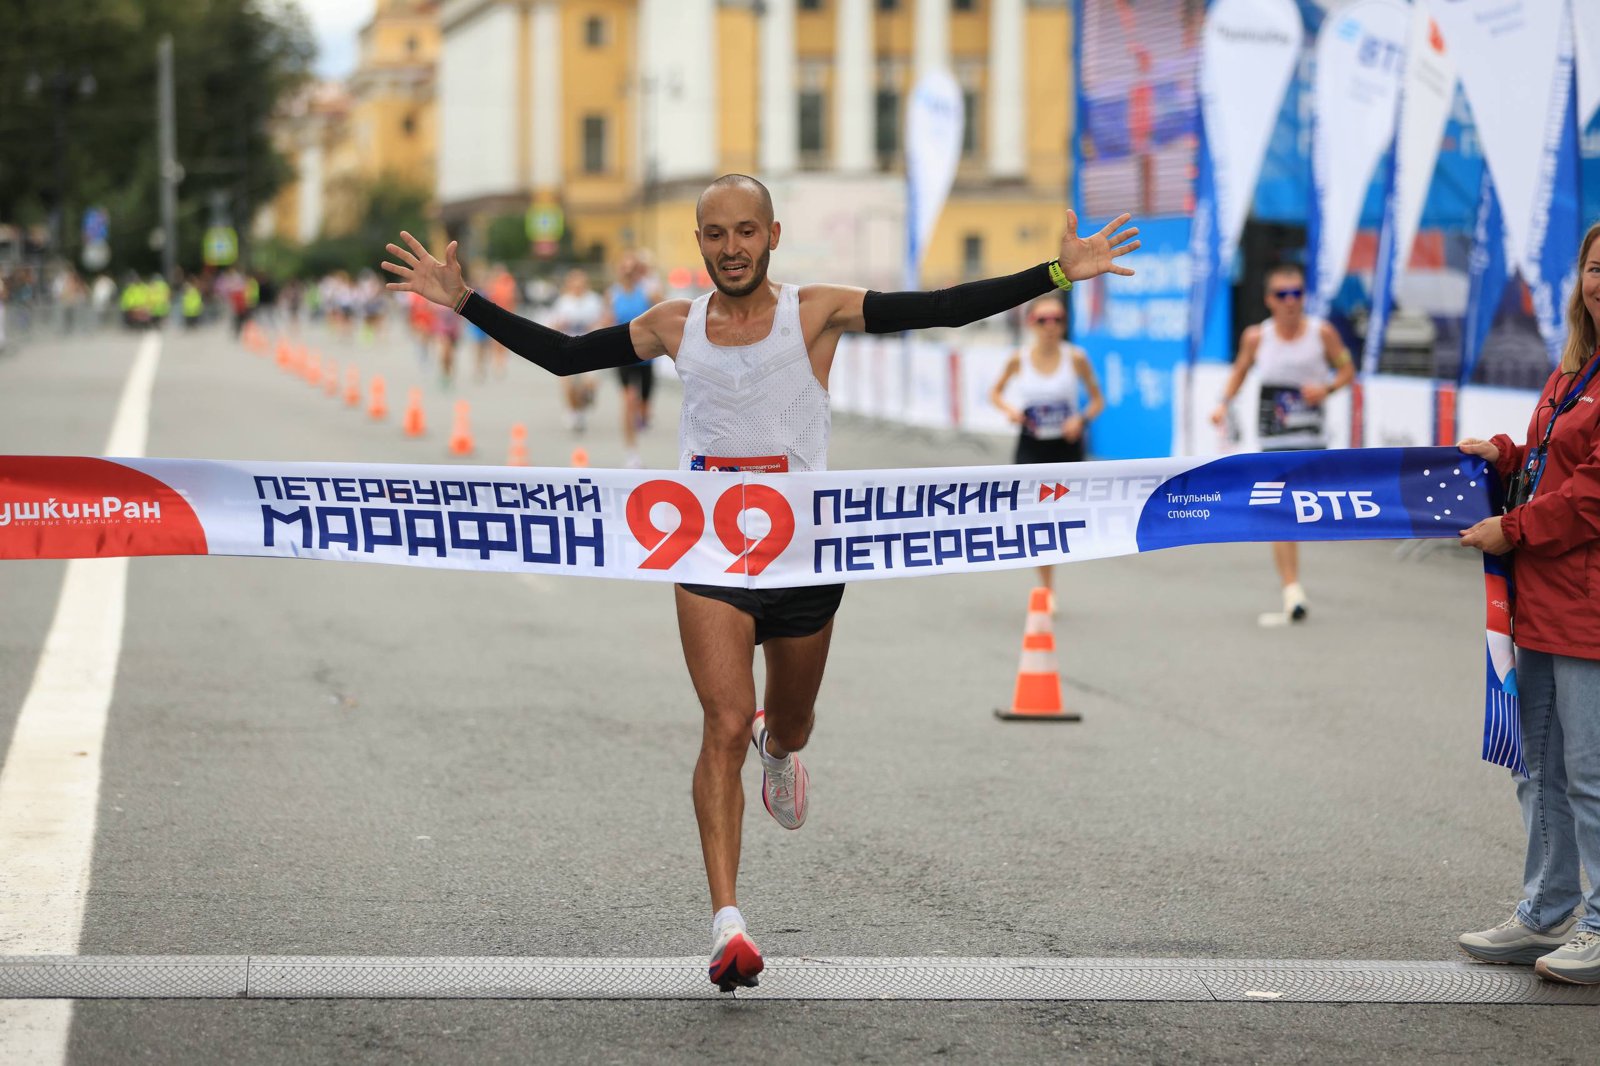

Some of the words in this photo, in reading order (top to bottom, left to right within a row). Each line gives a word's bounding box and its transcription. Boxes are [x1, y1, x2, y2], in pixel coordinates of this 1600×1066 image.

[254, 476, 602, 513] ПЕТЕРБУРГСКИЙ
[813, 480, 1020, 526] ПУШКИН
[1166, 491, 1222, 506] Титульный
[1167, 509, 1210, 521] спонсор
[1291, 490, 1381, 524] ВТБ
[261, 505, 605, 567] МАРАФОН
[626, 480, 794, 576] 99
[814, 521, 1086, 574] ПЕТЕРБУРГ
